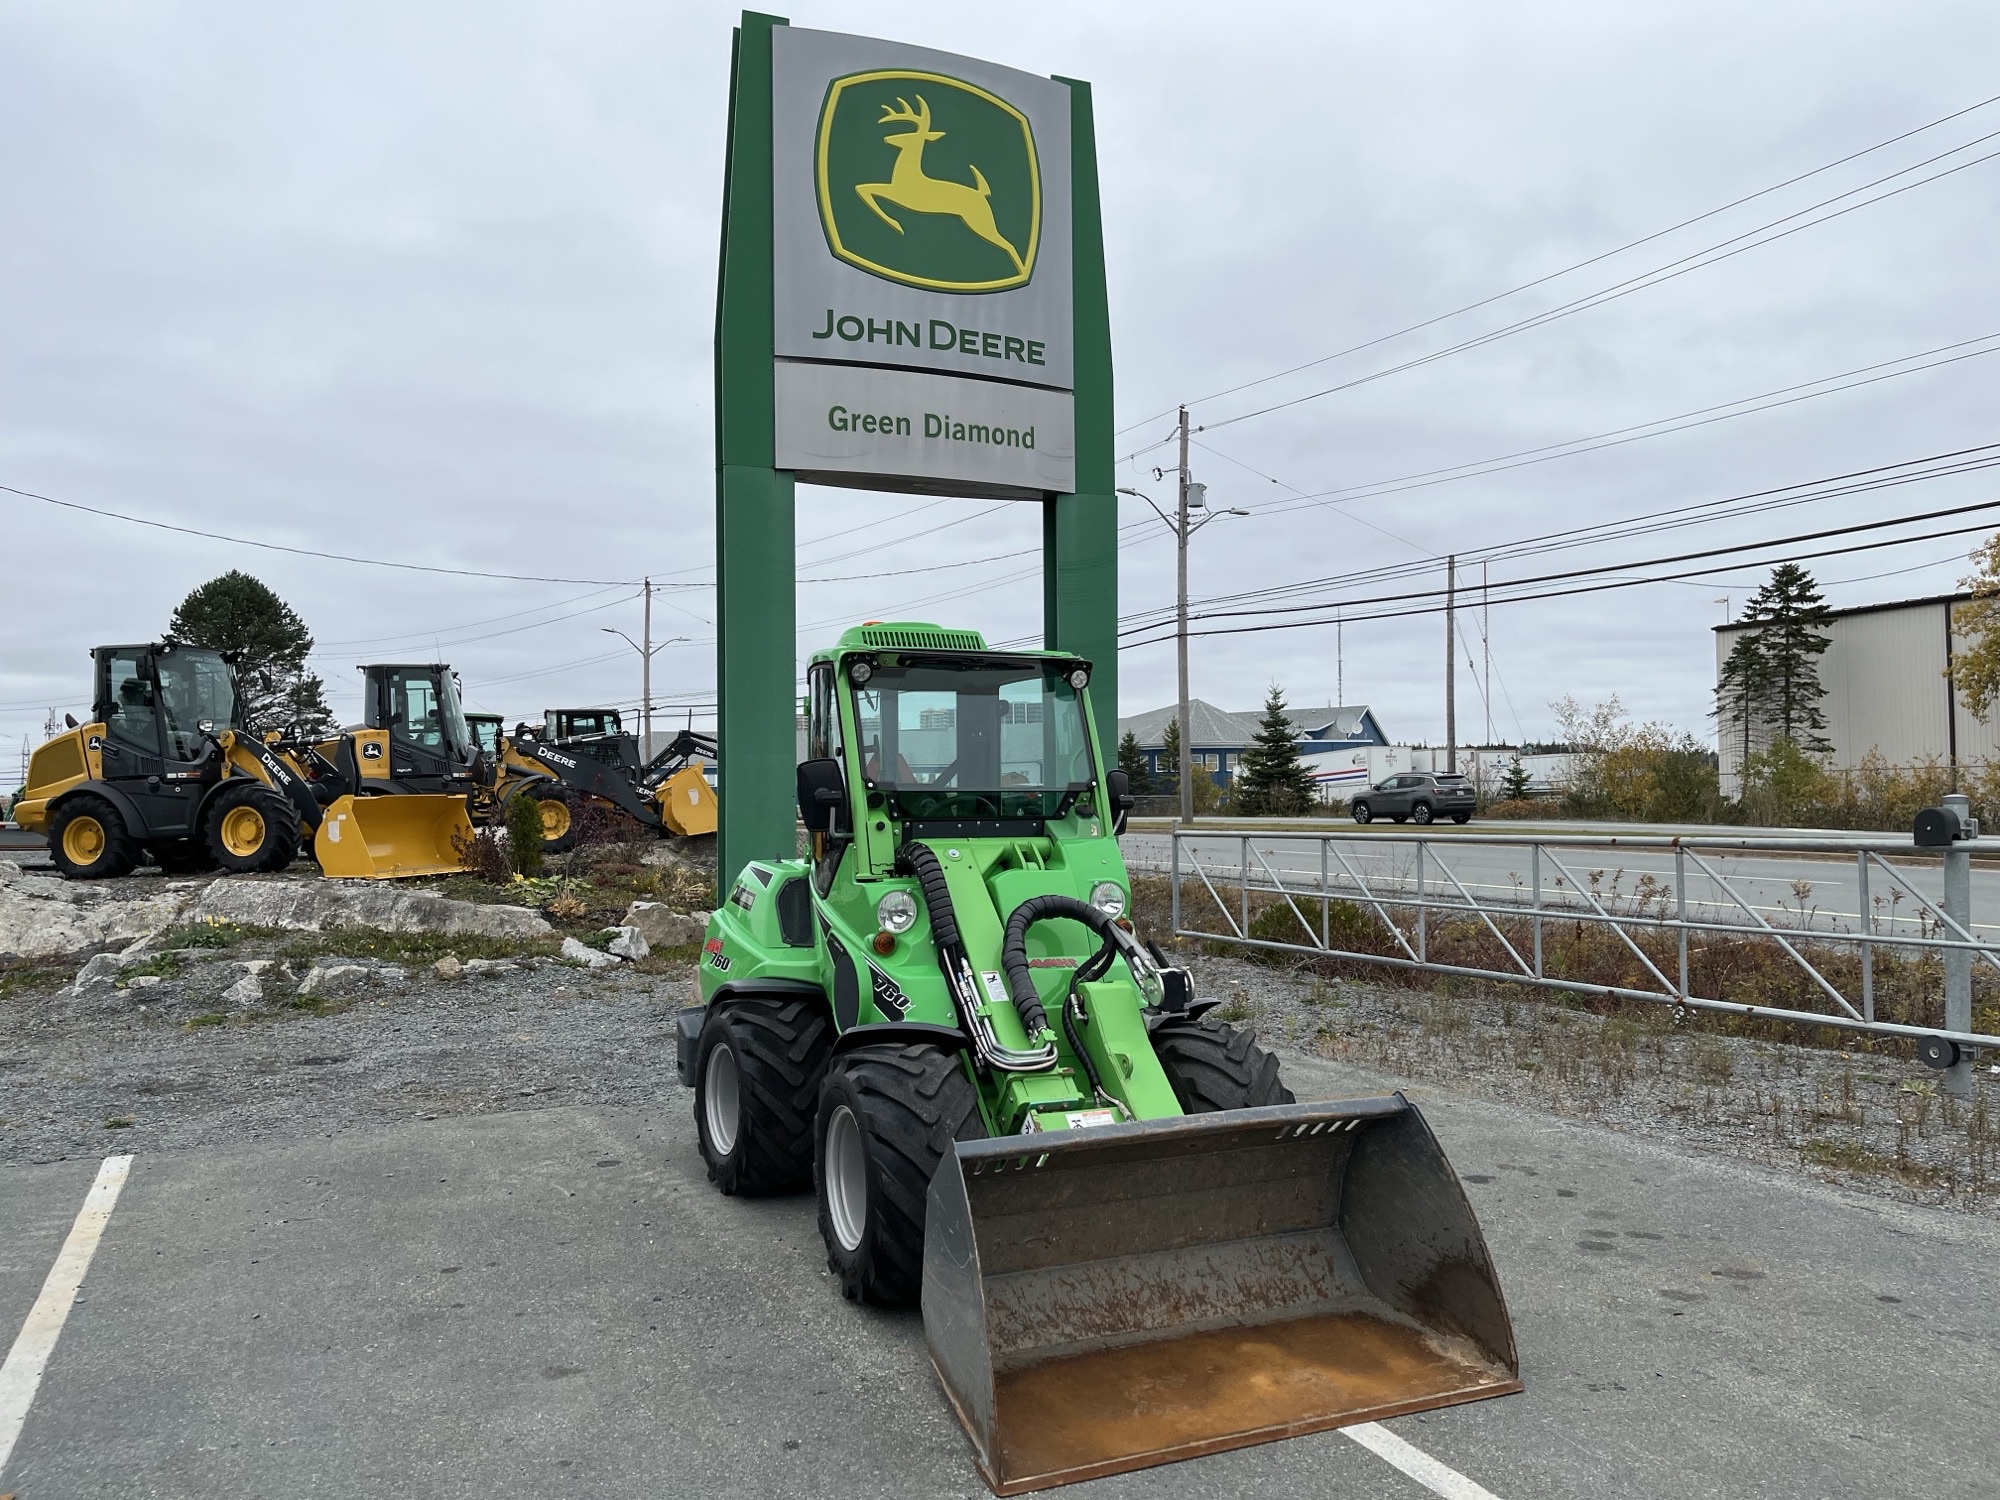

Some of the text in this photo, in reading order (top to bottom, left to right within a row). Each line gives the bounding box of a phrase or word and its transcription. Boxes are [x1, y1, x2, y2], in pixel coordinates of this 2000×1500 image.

[812, 309, 1046, 366] JOHN DEERE
[828, 405, 1035, 450] Green Diamond
[537, 746, 577, 769] DEERE
[694, 746, 715, 758] DEERE
[261, 752, 292, 786] DEERE
[636, 786, 657, 797] ERE
[709, 952, 732, 972] 760
[873, 975, 912, 1010] 760
